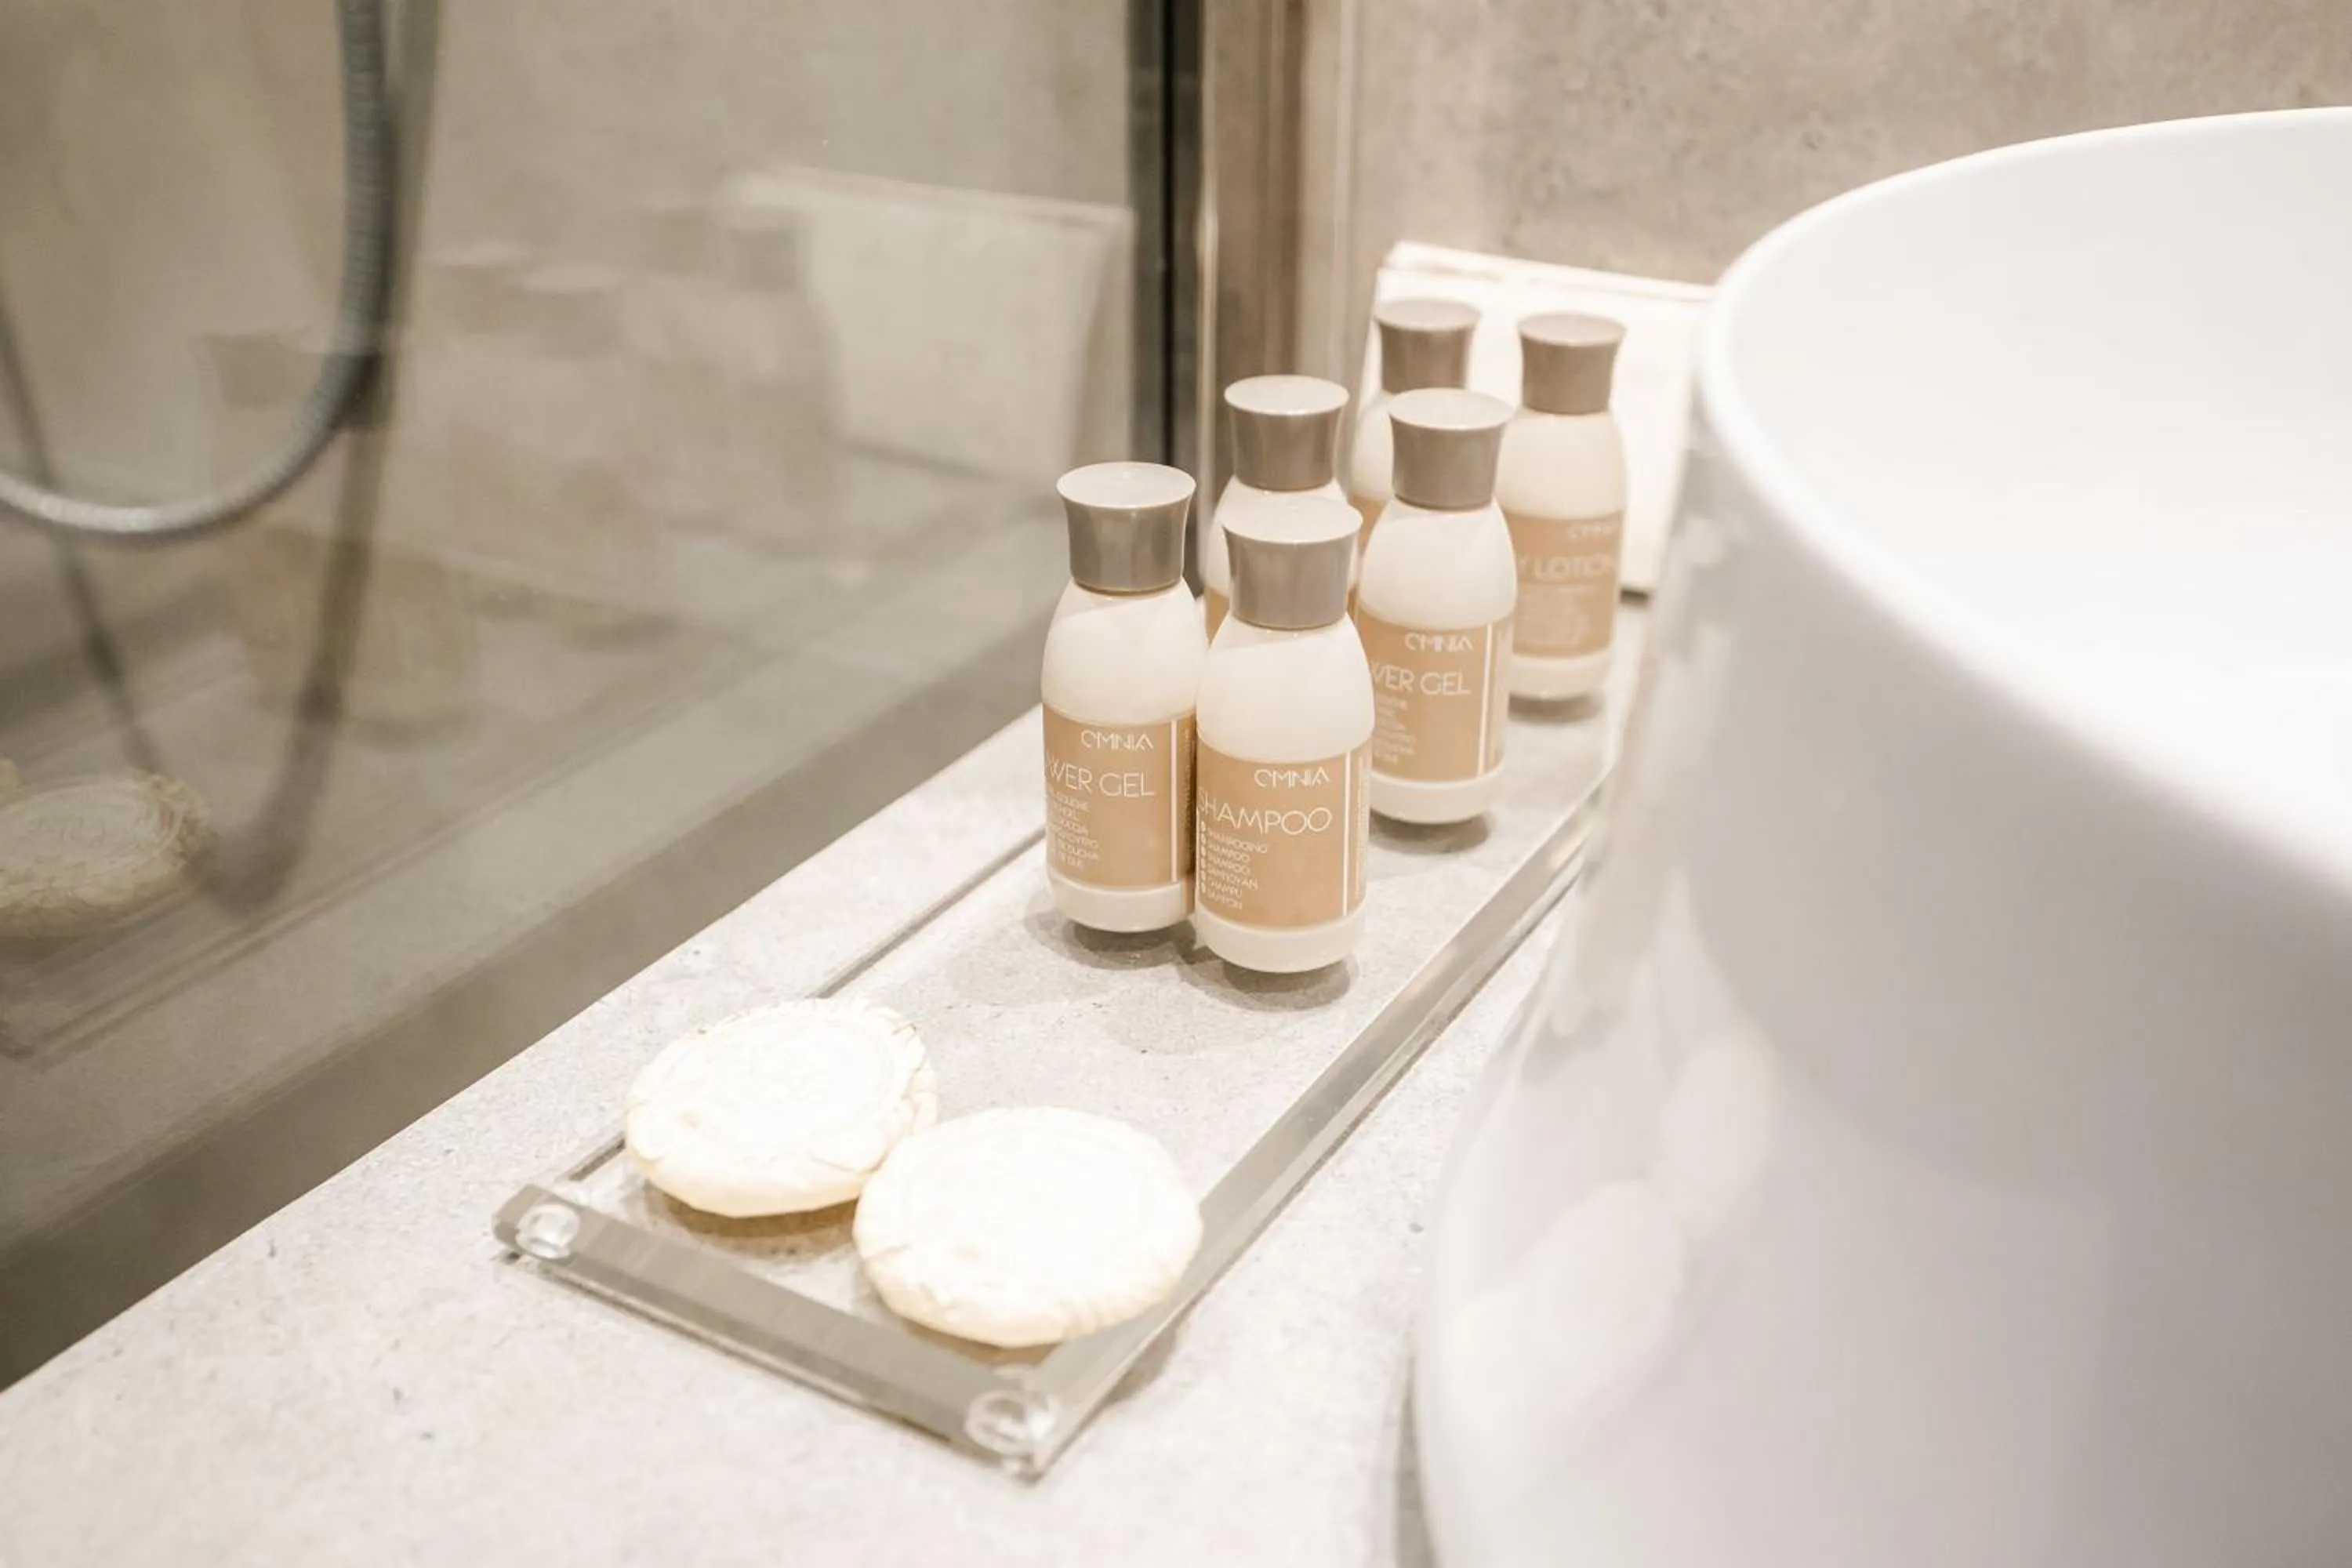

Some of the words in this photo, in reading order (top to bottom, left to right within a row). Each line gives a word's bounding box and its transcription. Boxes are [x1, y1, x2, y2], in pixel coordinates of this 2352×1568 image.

[1421, 670, 1471, 695] GEL
[1098, 771, 1157, 798] GEL
[1198, 788, 1333, 836] SHAMPOO
